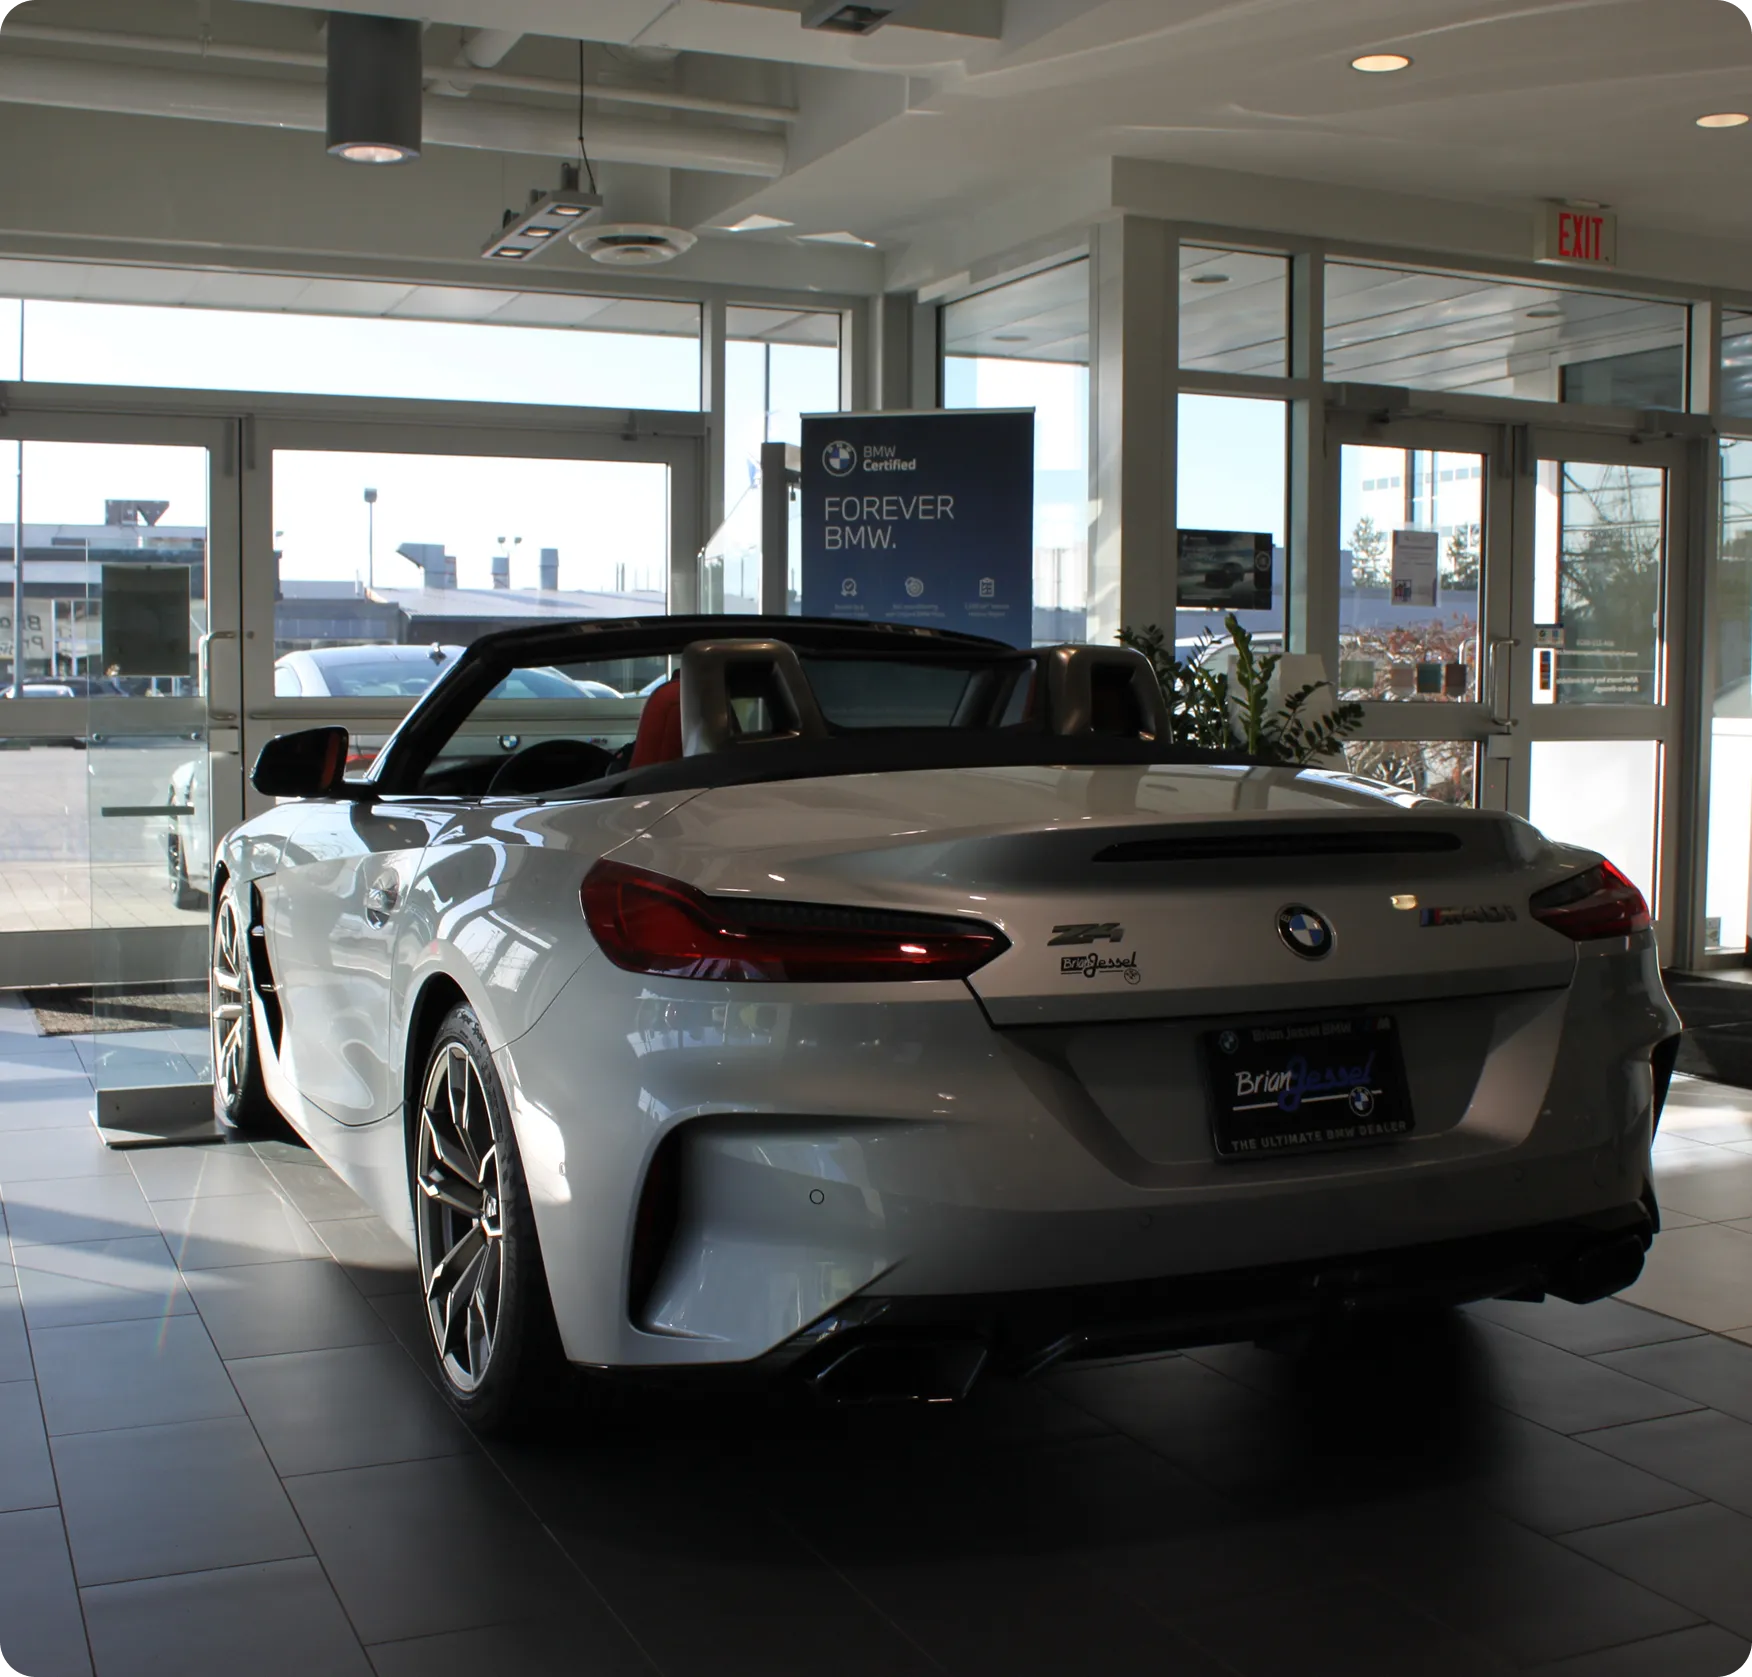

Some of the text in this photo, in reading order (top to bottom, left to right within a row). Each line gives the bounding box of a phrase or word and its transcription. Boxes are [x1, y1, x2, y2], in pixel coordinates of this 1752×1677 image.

[1558, 212, 1603, 260] EXIT
[863, 445, 896, 458] BMW
[862, 458, 916, 471] Certified
[825, 495, 954, 521] FOREVER
[825, 525, 897, 550] BMW.
[1047, 923, 1124, 946] Z4
[1084, 951, 1137, 978] Jessel
[1251, 1027, 1284, 1042] Brian
[1321, 1020, 1352, 1036] BMW
[1234, 1049, 1377, 1113] Brian Jessel
[1230, 1120, 1407, 1152] THE ULTIMATE BMW DEALER
